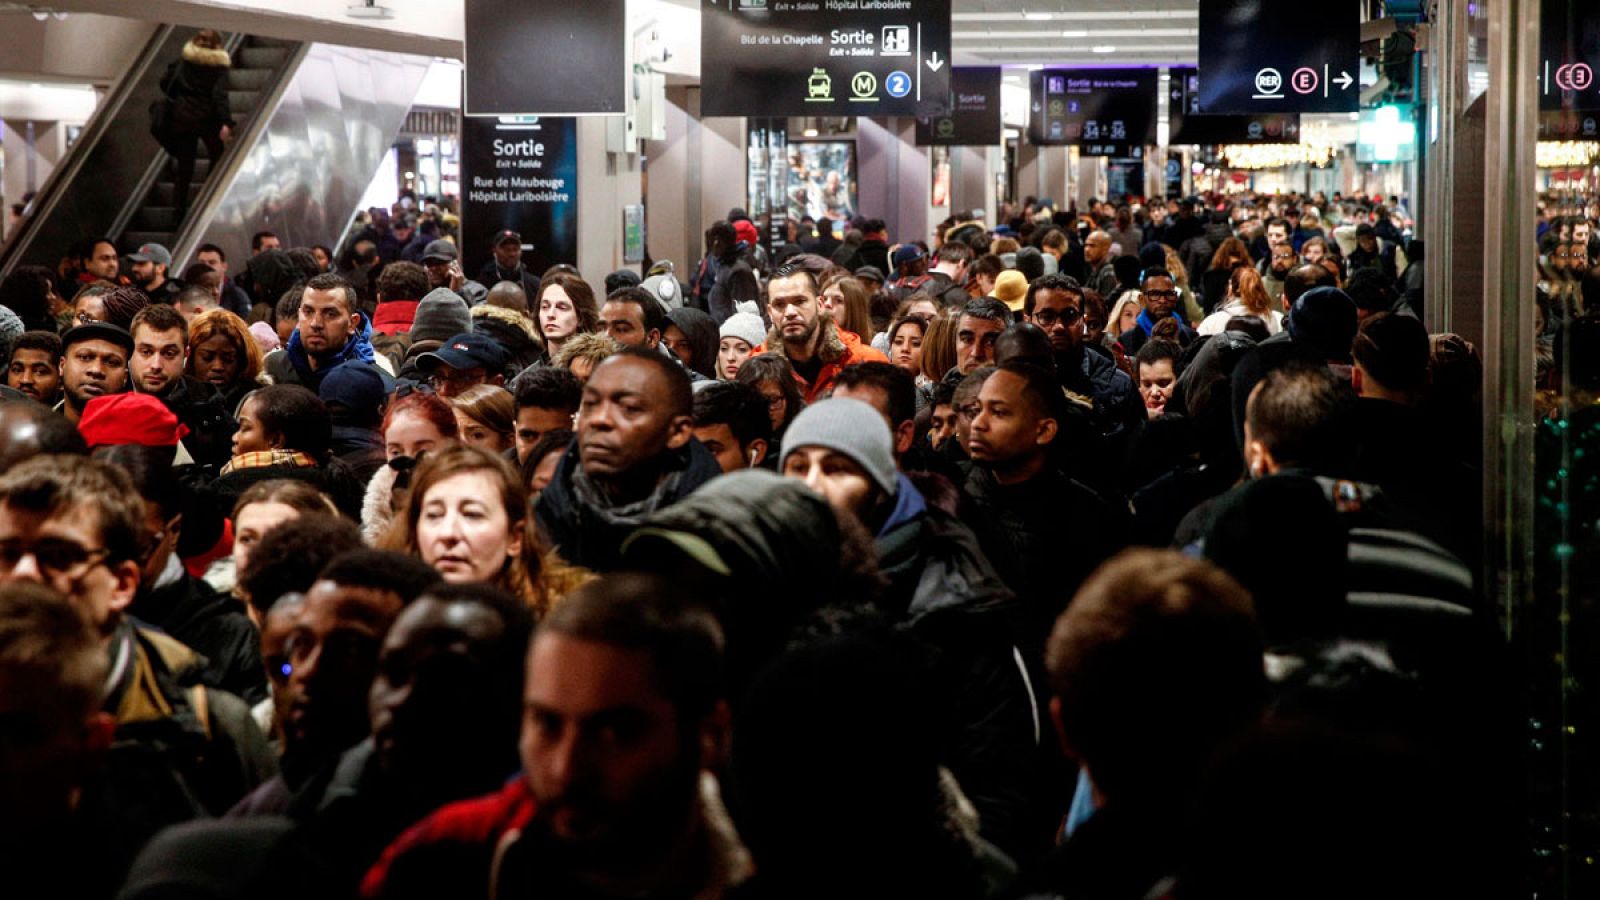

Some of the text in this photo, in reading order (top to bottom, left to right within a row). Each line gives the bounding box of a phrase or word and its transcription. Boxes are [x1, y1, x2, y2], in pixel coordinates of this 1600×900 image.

[825, 0, 912, 12] Hôpital Lariboisière
[758, 34, 769, 45] de
[772, 34, 781, 45] la
[783, 34, 824, 47] Chapelle
[830, 29, 874, 45] Sortie
[829, 47, 844, 56] Exit
[857, 77, 871, 92] M
[892, 76, 905, 92] 2
[1067, 78, 1091, 88] Sortie
[1259, 75, 1279, 86] RER
[1299, 74, 1310, 88] E
[959, 93, 986, 103] Sortie
[493, 138, 545, 156] Sortie
[495, 159, 511, 169] Exit
[473, 176, 565, 190] Rue de Maubeuge
[469, 190, 569, 204] Hôpital Lariboisière
